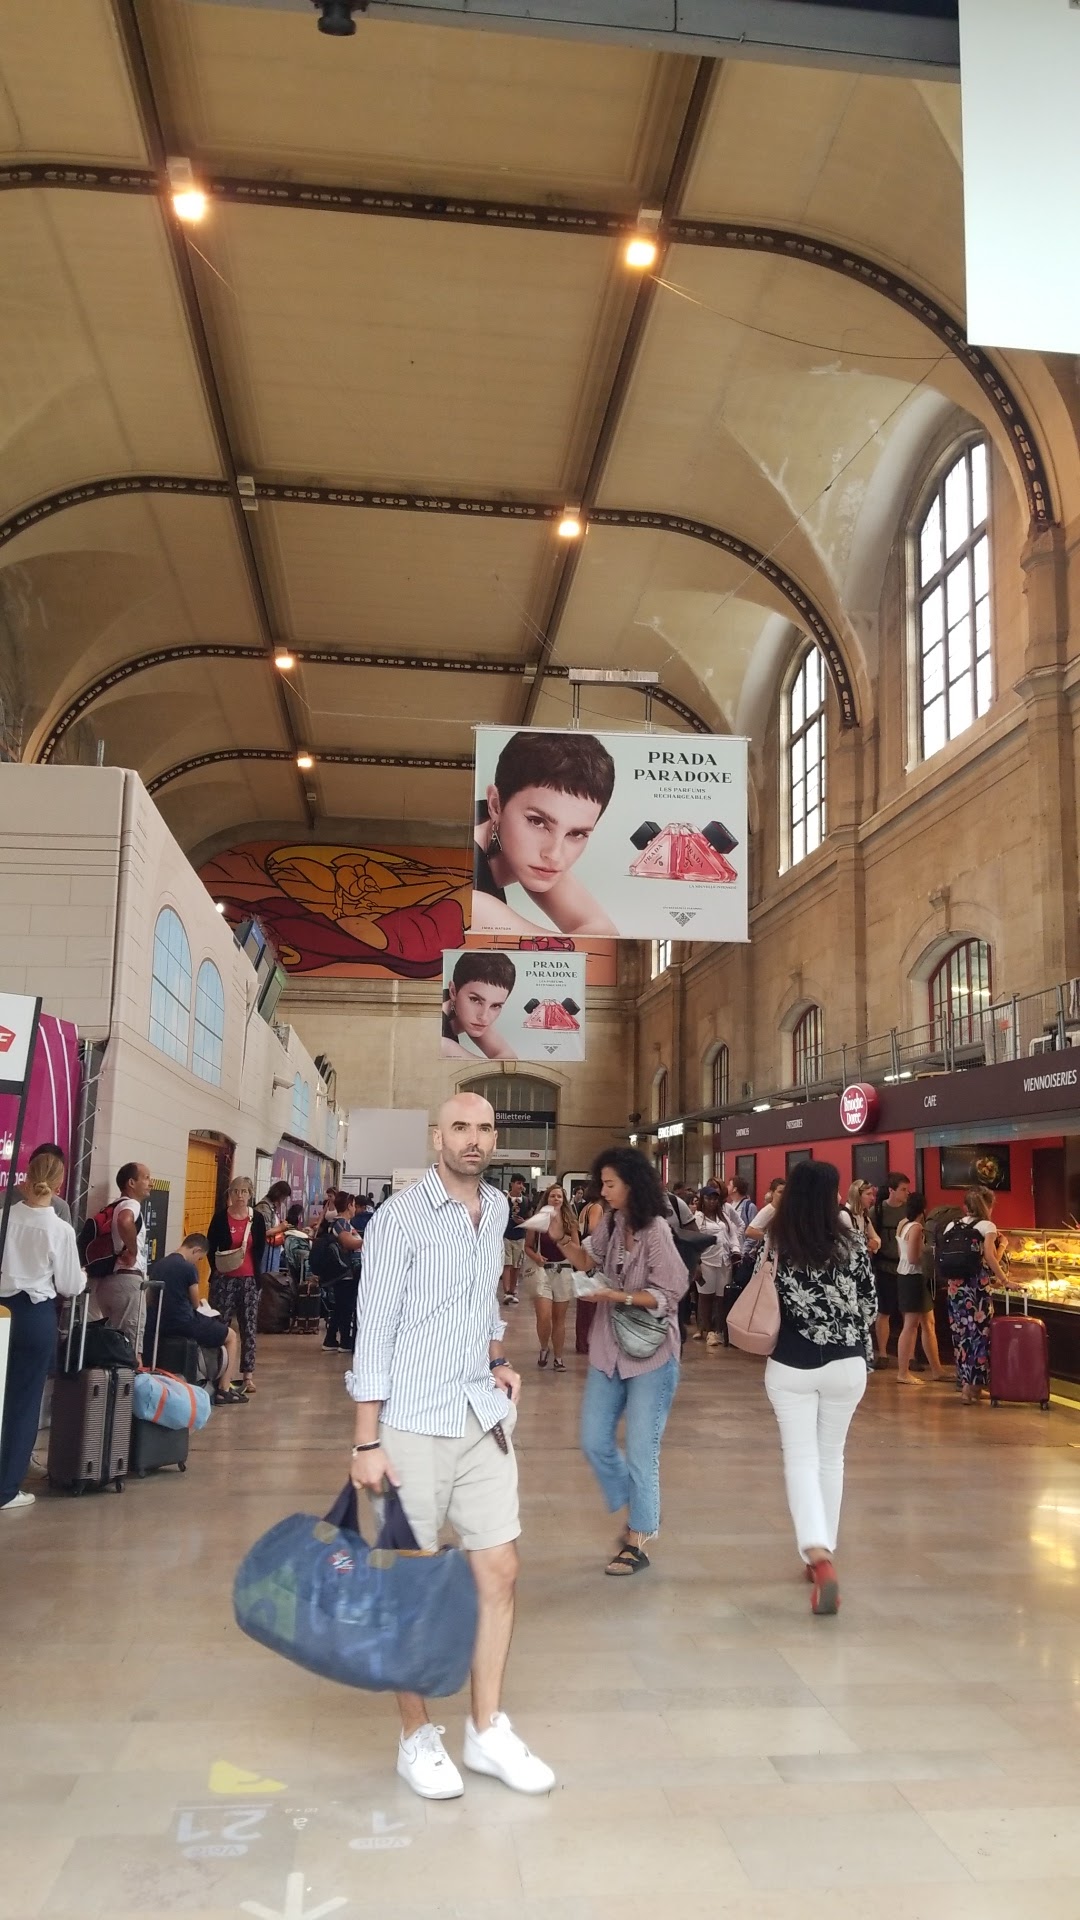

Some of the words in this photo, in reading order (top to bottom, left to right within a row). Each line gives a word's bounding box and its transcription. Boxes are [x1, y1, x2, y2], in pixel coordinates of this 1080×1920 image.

[648, 751, 717, 766] PRADA
[634, 769, 733, 783] PARADOXE
[533, 961, 570, 969] PRADA
[525, 970, 578, 979] PARADOXE
[1023, 1069, 1077, 1092] VIENNOISERIES
[843, 1092, 864, 1112] Brioche
[495, 1112, 532, 1120] Billetterie
[177, 1809, 266, 1843] 21
